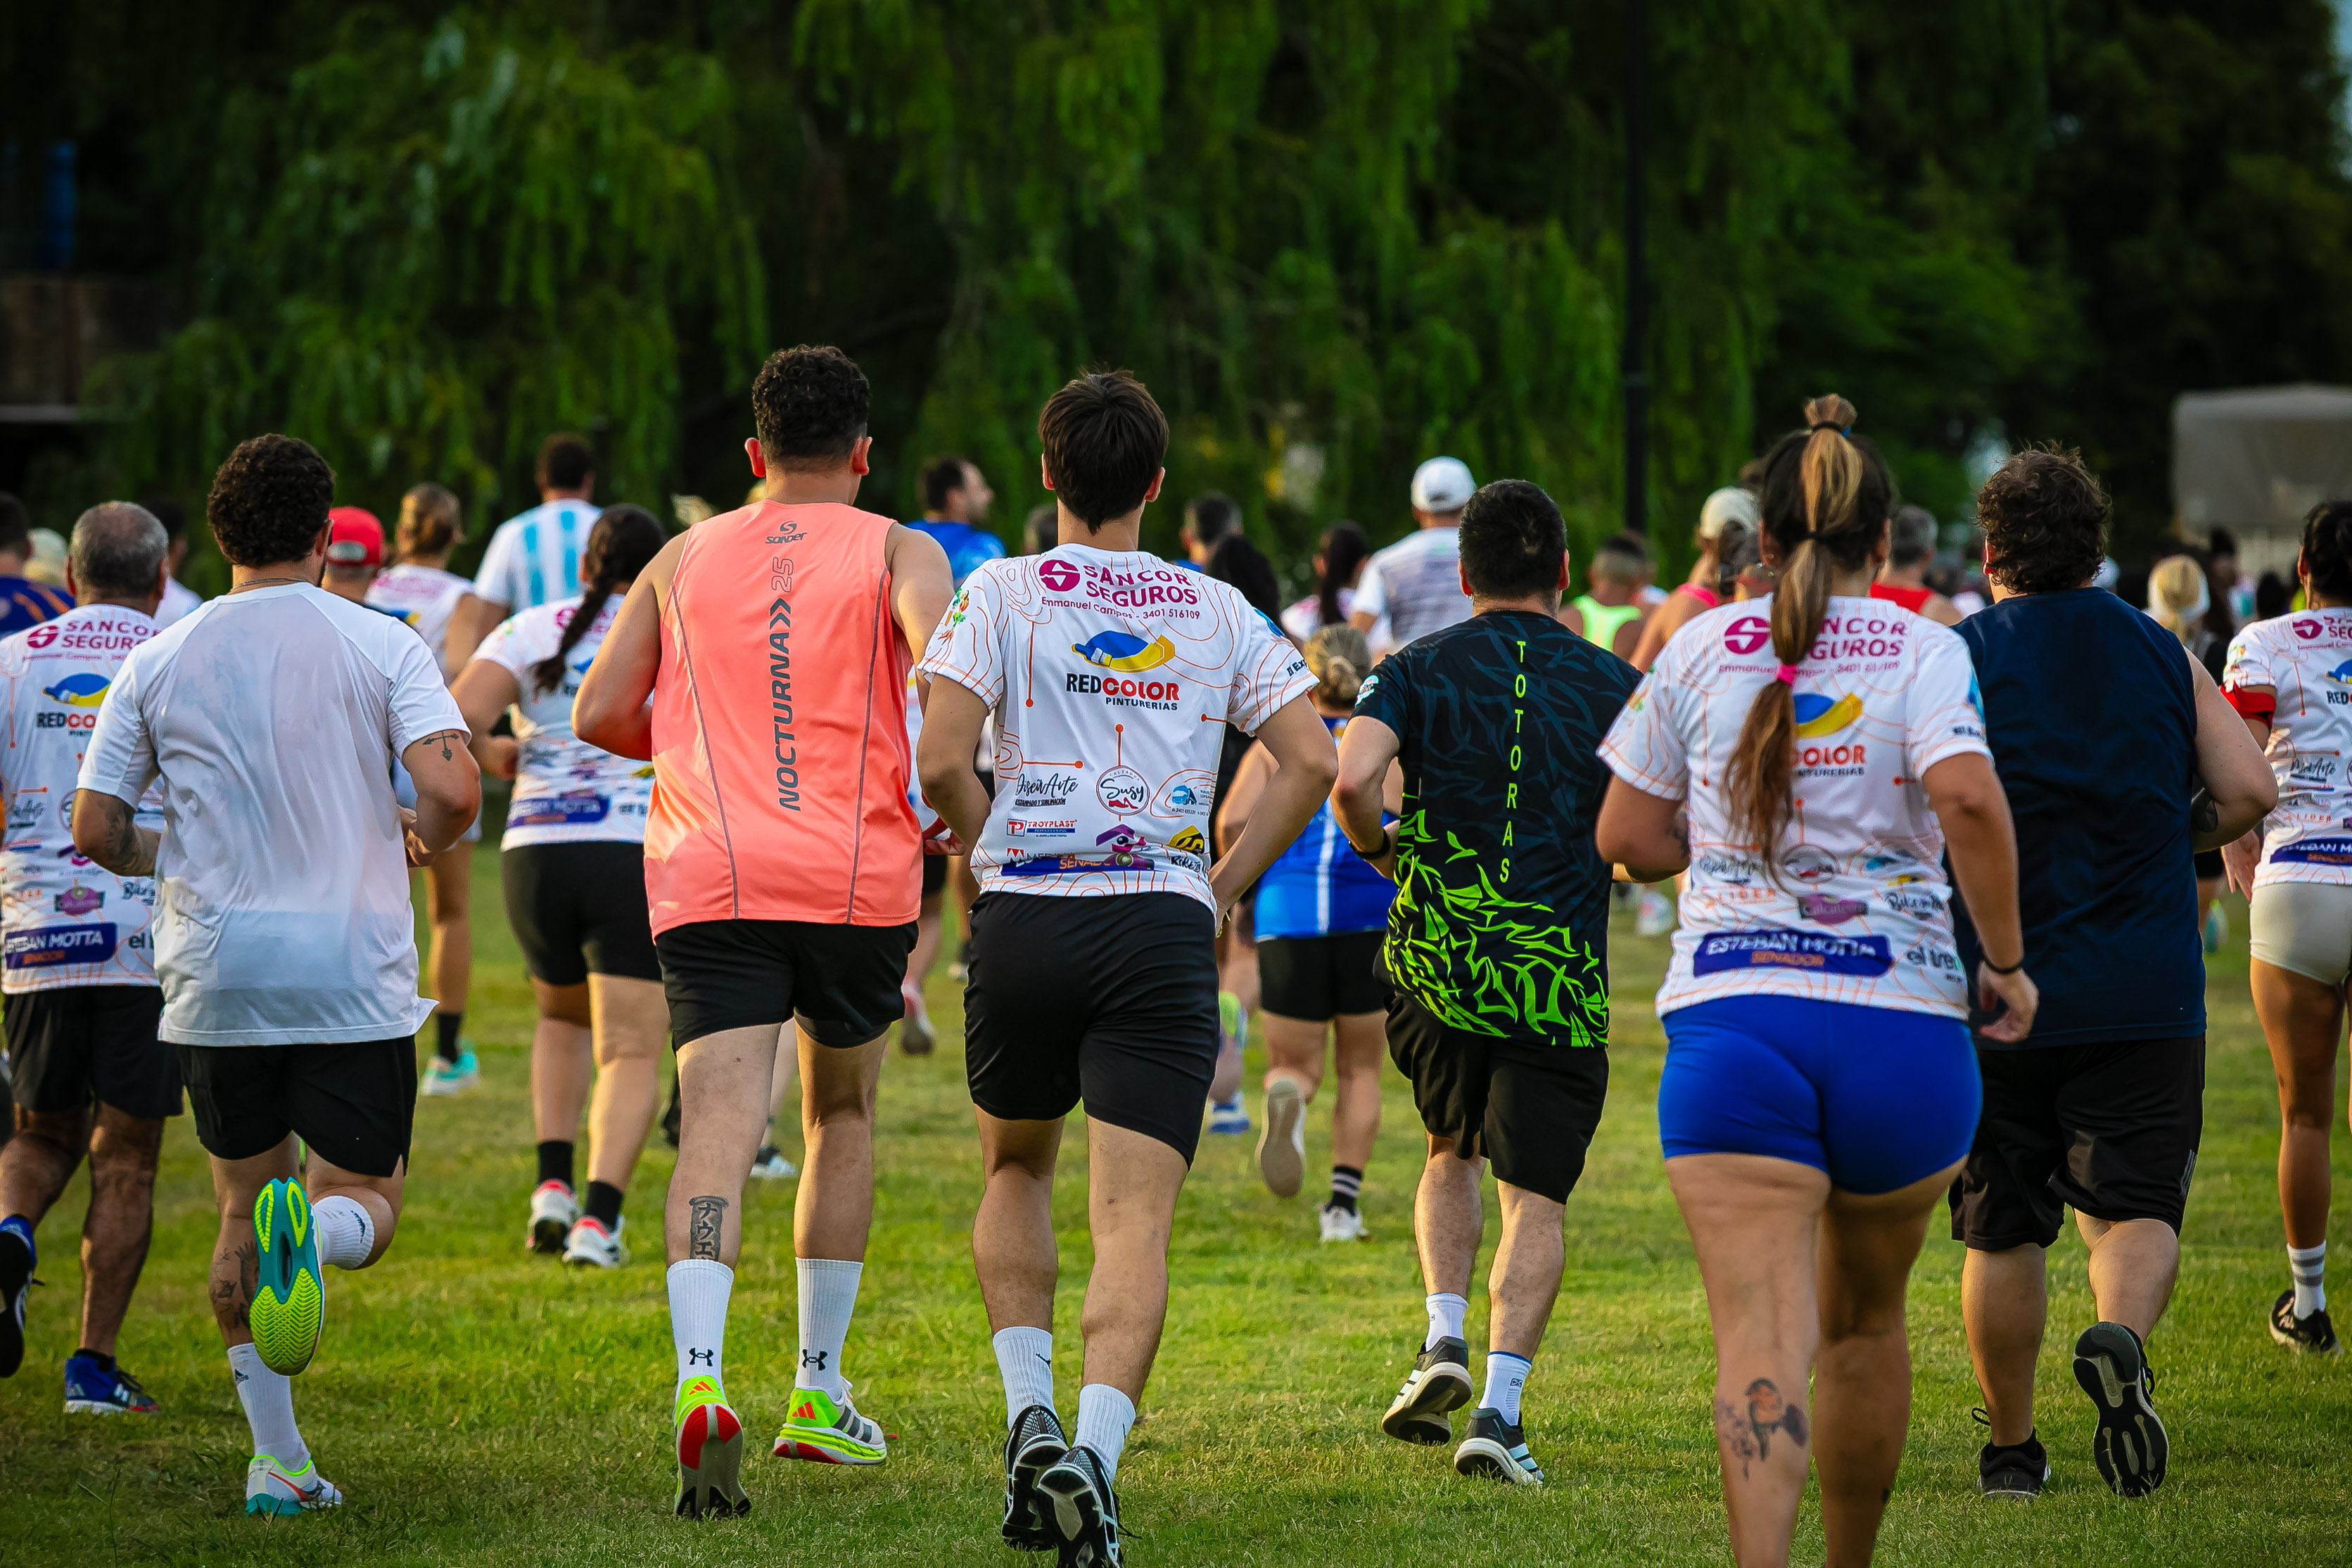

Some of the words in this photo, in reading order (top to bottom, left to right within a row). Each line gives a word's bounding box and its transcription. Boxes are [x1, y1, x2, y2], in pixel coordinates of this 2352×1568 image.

[771, 556, 794, 593] 25
[1083, 564, 1194, 586] SANCOR
[1086, 580, 1197, 607] SEGUROS
[1041, 597, 1091, 610] Emmanuel
[1093, 605, 1133, 620] Campos
[1143, 609, 1165, 620] 3401
[1168, 609, 1200, 620] 516109
[1819, 617, 1907, 636] NCOR
[1810, 638, 1904, 660] GUROS
[1066, 673, 1180, 701] REDCOLOR
[1105, 697, 1178, 710] PINTURERIAS
[37, 711, 96, 729] REDCO
[769, 632, 801, 812] NOCTURNA
[1499, 640, 1526, 883] TOTORAS
[1100, 778, 1144, 803] Susy
[49, 931, 103, 948] MOTTA
[695, 1202, 718, 1259] ナウエ
